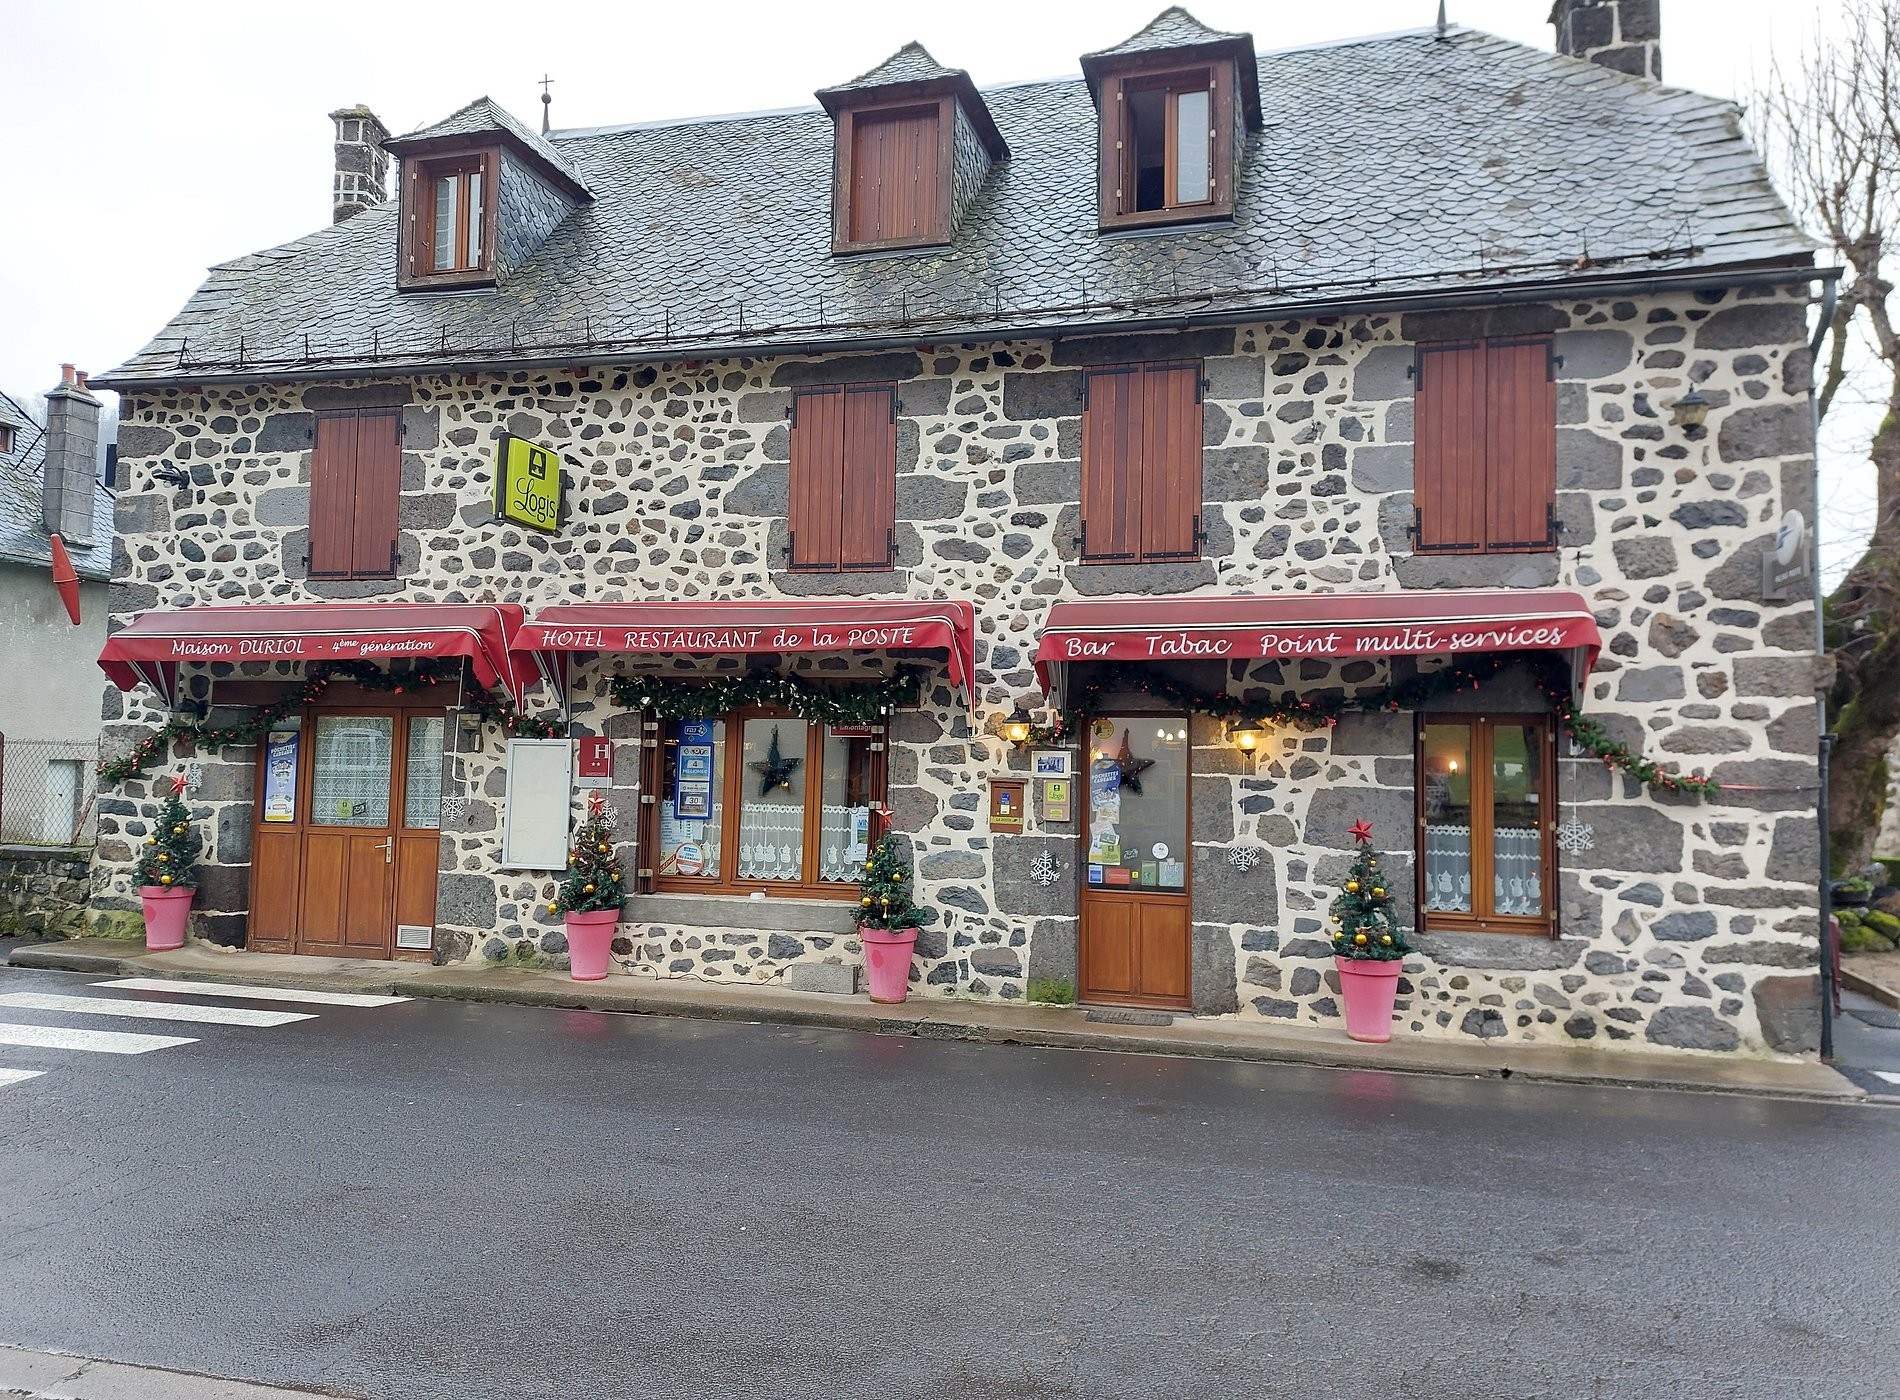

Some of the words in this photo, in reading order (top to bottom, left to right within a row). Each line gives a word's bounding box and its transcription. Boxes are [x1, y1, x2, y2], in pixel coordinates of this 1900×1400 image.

[513, 477, 556, 523] Logis
[171, 639, 233, 655] Maison
[239, 638, 305, 655] DURIOL
[331, 638, 359, 653] 4ème
[360, 639, 436, 656] génération
[541, 629, 606, 647] HOTEL
[624, 630, 761, 649] RESTAURANT
[773, 629, 803, 647] de
[812, 628, 839, 647] la
[847, 626, 916, 647] POSTE
[1065, 637, 1115, 657] Bar
[1145, 632, 1233, 656] Tabac
[1260, 632, 1342, 656] Point
[1356, 626, 1568, 652] multi-services
[594, 743, 609, 759] H
